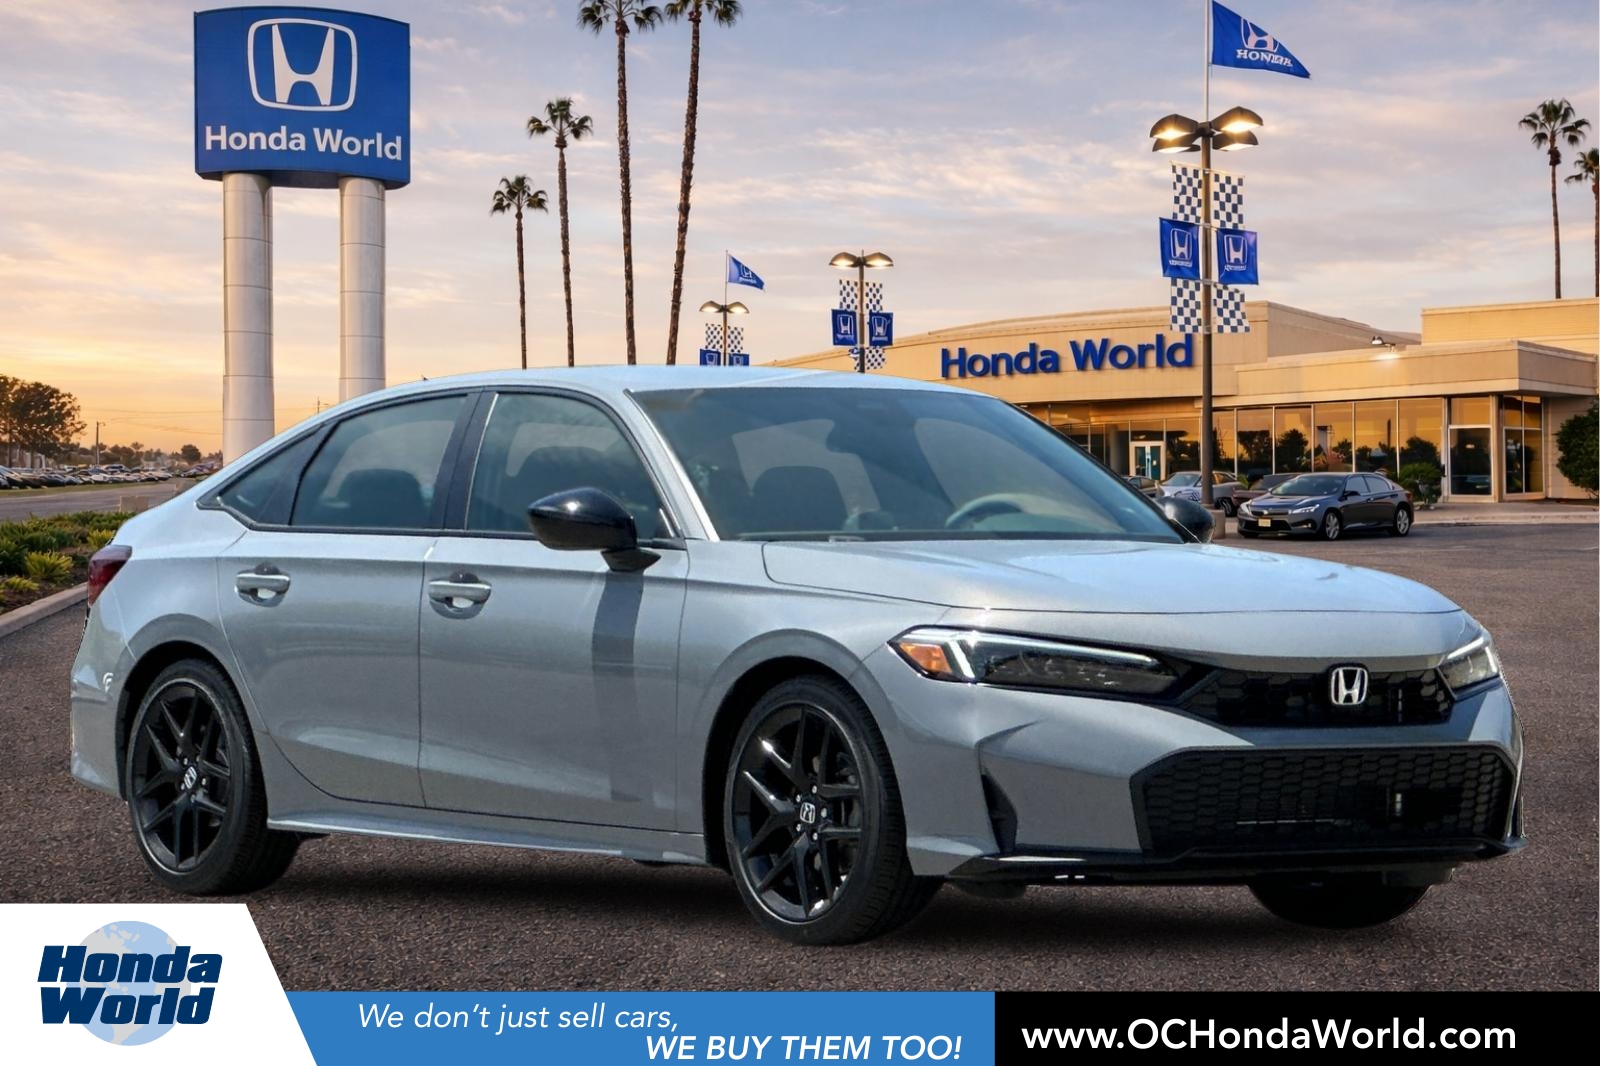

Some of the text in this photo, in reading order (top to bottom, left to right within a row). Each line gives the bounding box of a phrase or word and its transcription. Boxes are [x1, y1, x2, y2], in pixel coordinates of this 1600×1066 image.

[206, 126, 401, 161] Honda World
[941, 333, 1194, 378] Honda World
